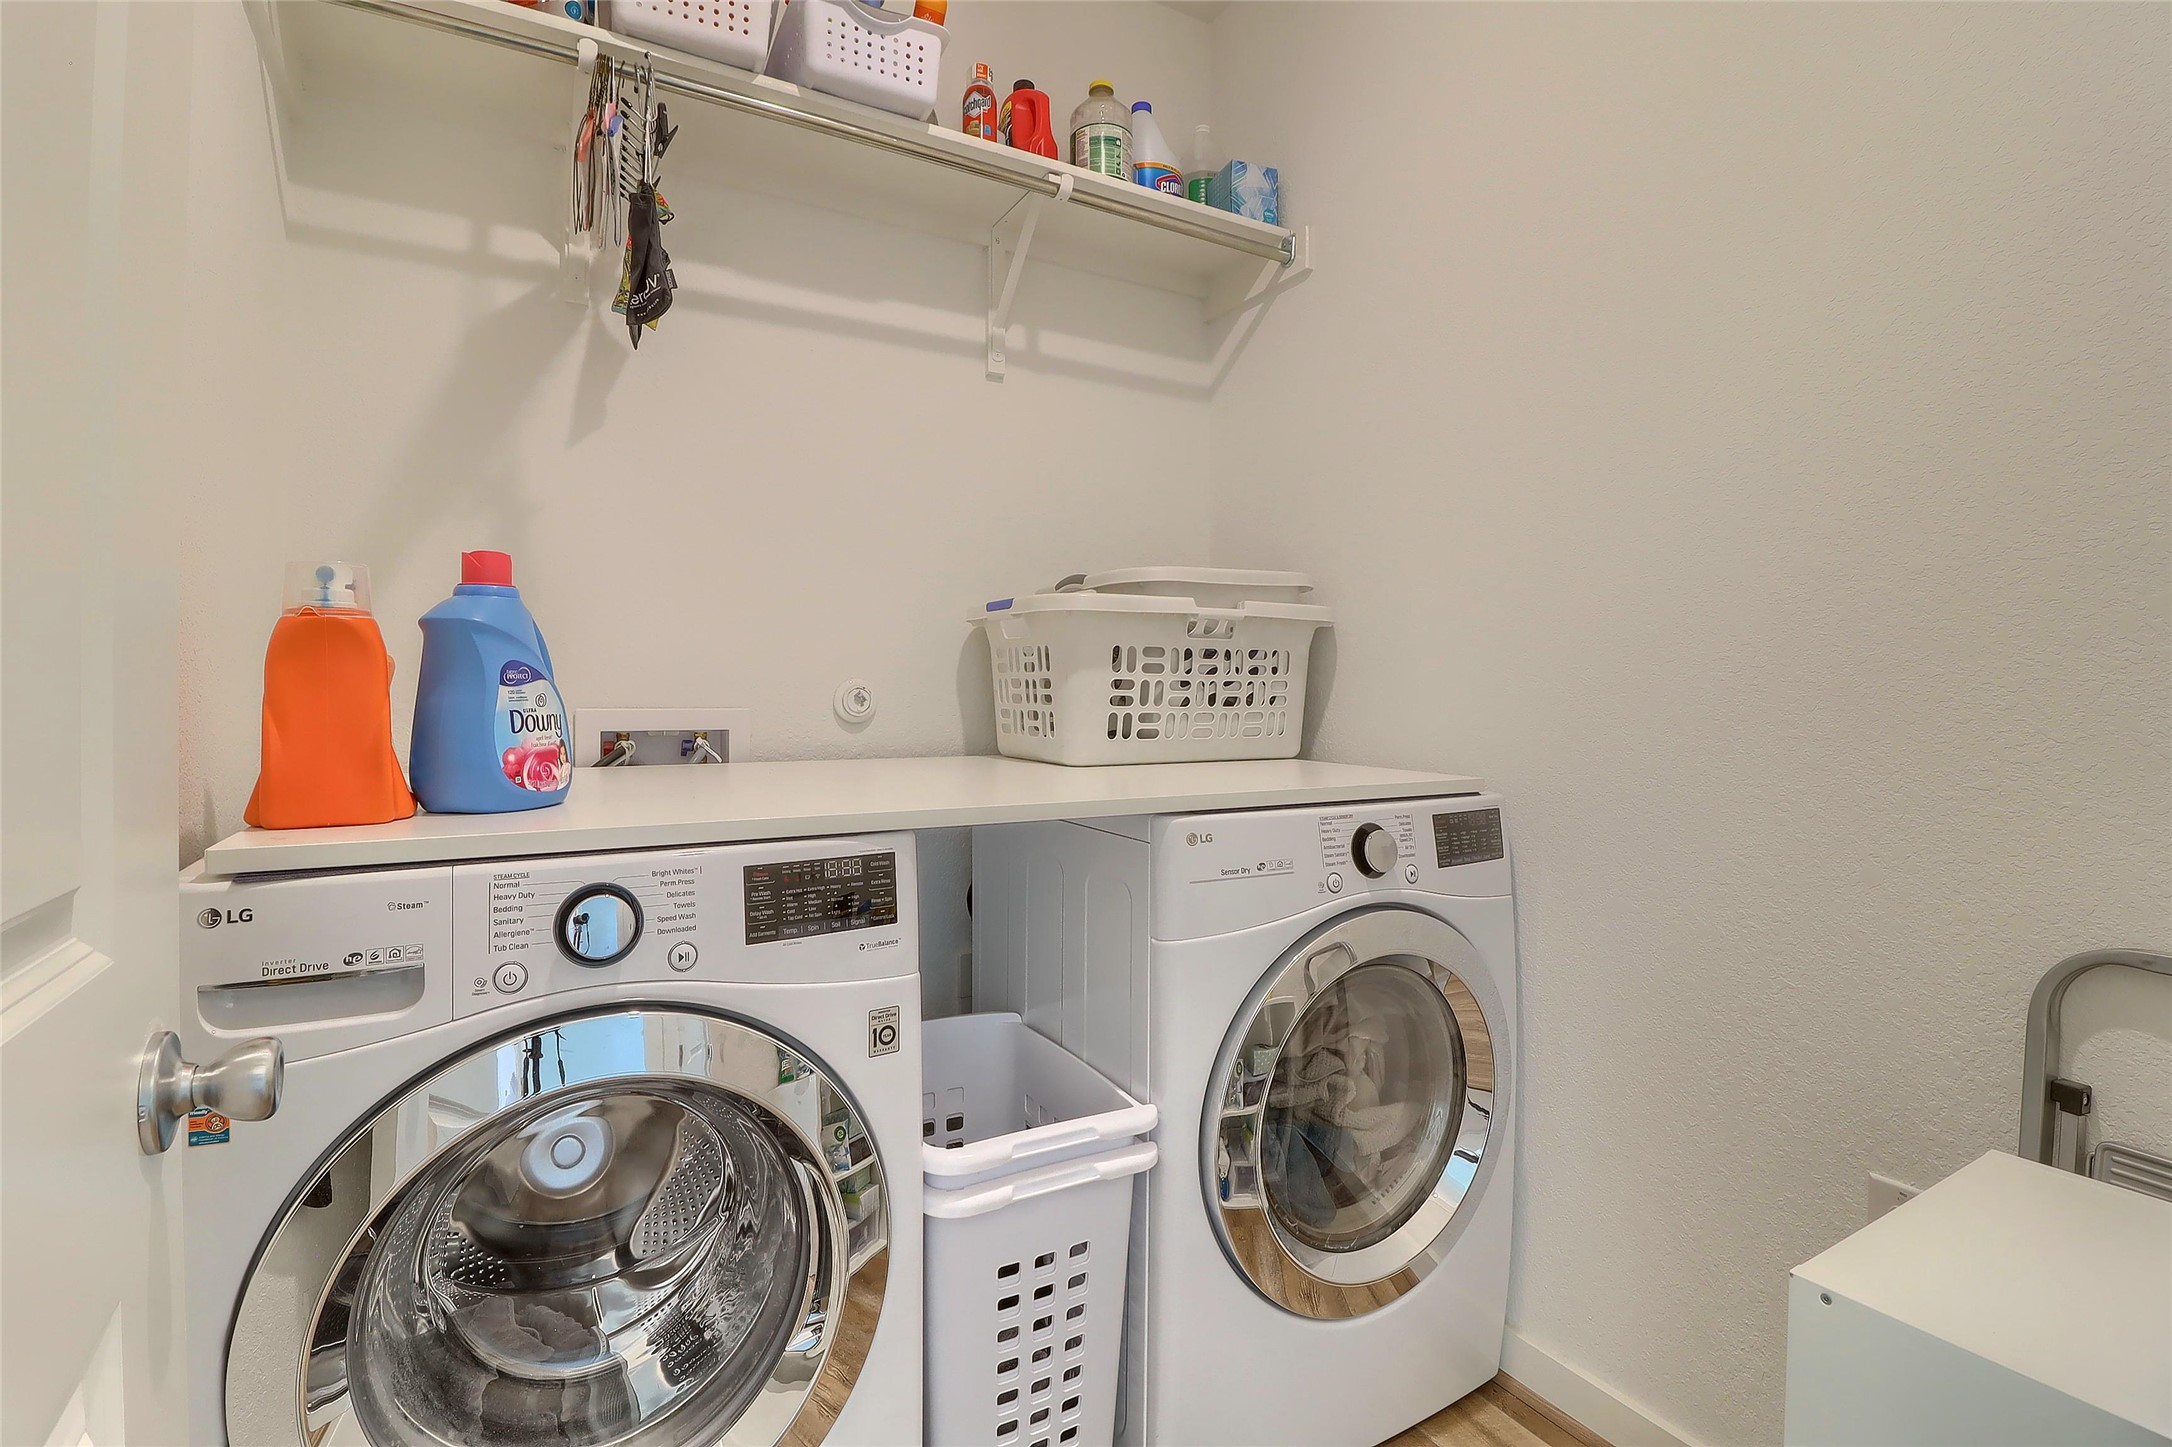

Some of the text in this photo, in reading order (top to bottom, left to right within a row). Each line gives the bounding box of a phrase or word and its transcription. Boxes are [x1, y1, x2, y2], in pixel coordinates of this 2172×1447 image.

[509, 709, 563, 738] Downy
[1200, 833, 1213, 843] LG
[513, 871, 530, 879] CYCLE
[651, 869, 671, 877] Bright
[1220, 867, 1250, 876] Sensor Dry
[493, 881, 520, 890] Normal
[493, 891, 536, 901] Heavy Duty
[666, 890, 696, 898] Delicates
[493, 904, 523, 913] Bedding
[673, 901, 696, 909] Towels
[226, 908, 253, 924] LG
[656, 912, 697, 923] Speed Wash
[493, 917, 524, 926] Sanitary
[850, 917, 866, 926] Signal
[656, 924, 697, 935] Downloaded
[808, 924, 819, 932] Spin
[493, 942, 529, 952] Tub Clean
[262, 958, 296, 966] Inverter
[262, 961, 329, 977] Direct Drive
[872, 1025, 896, 1048] 10
